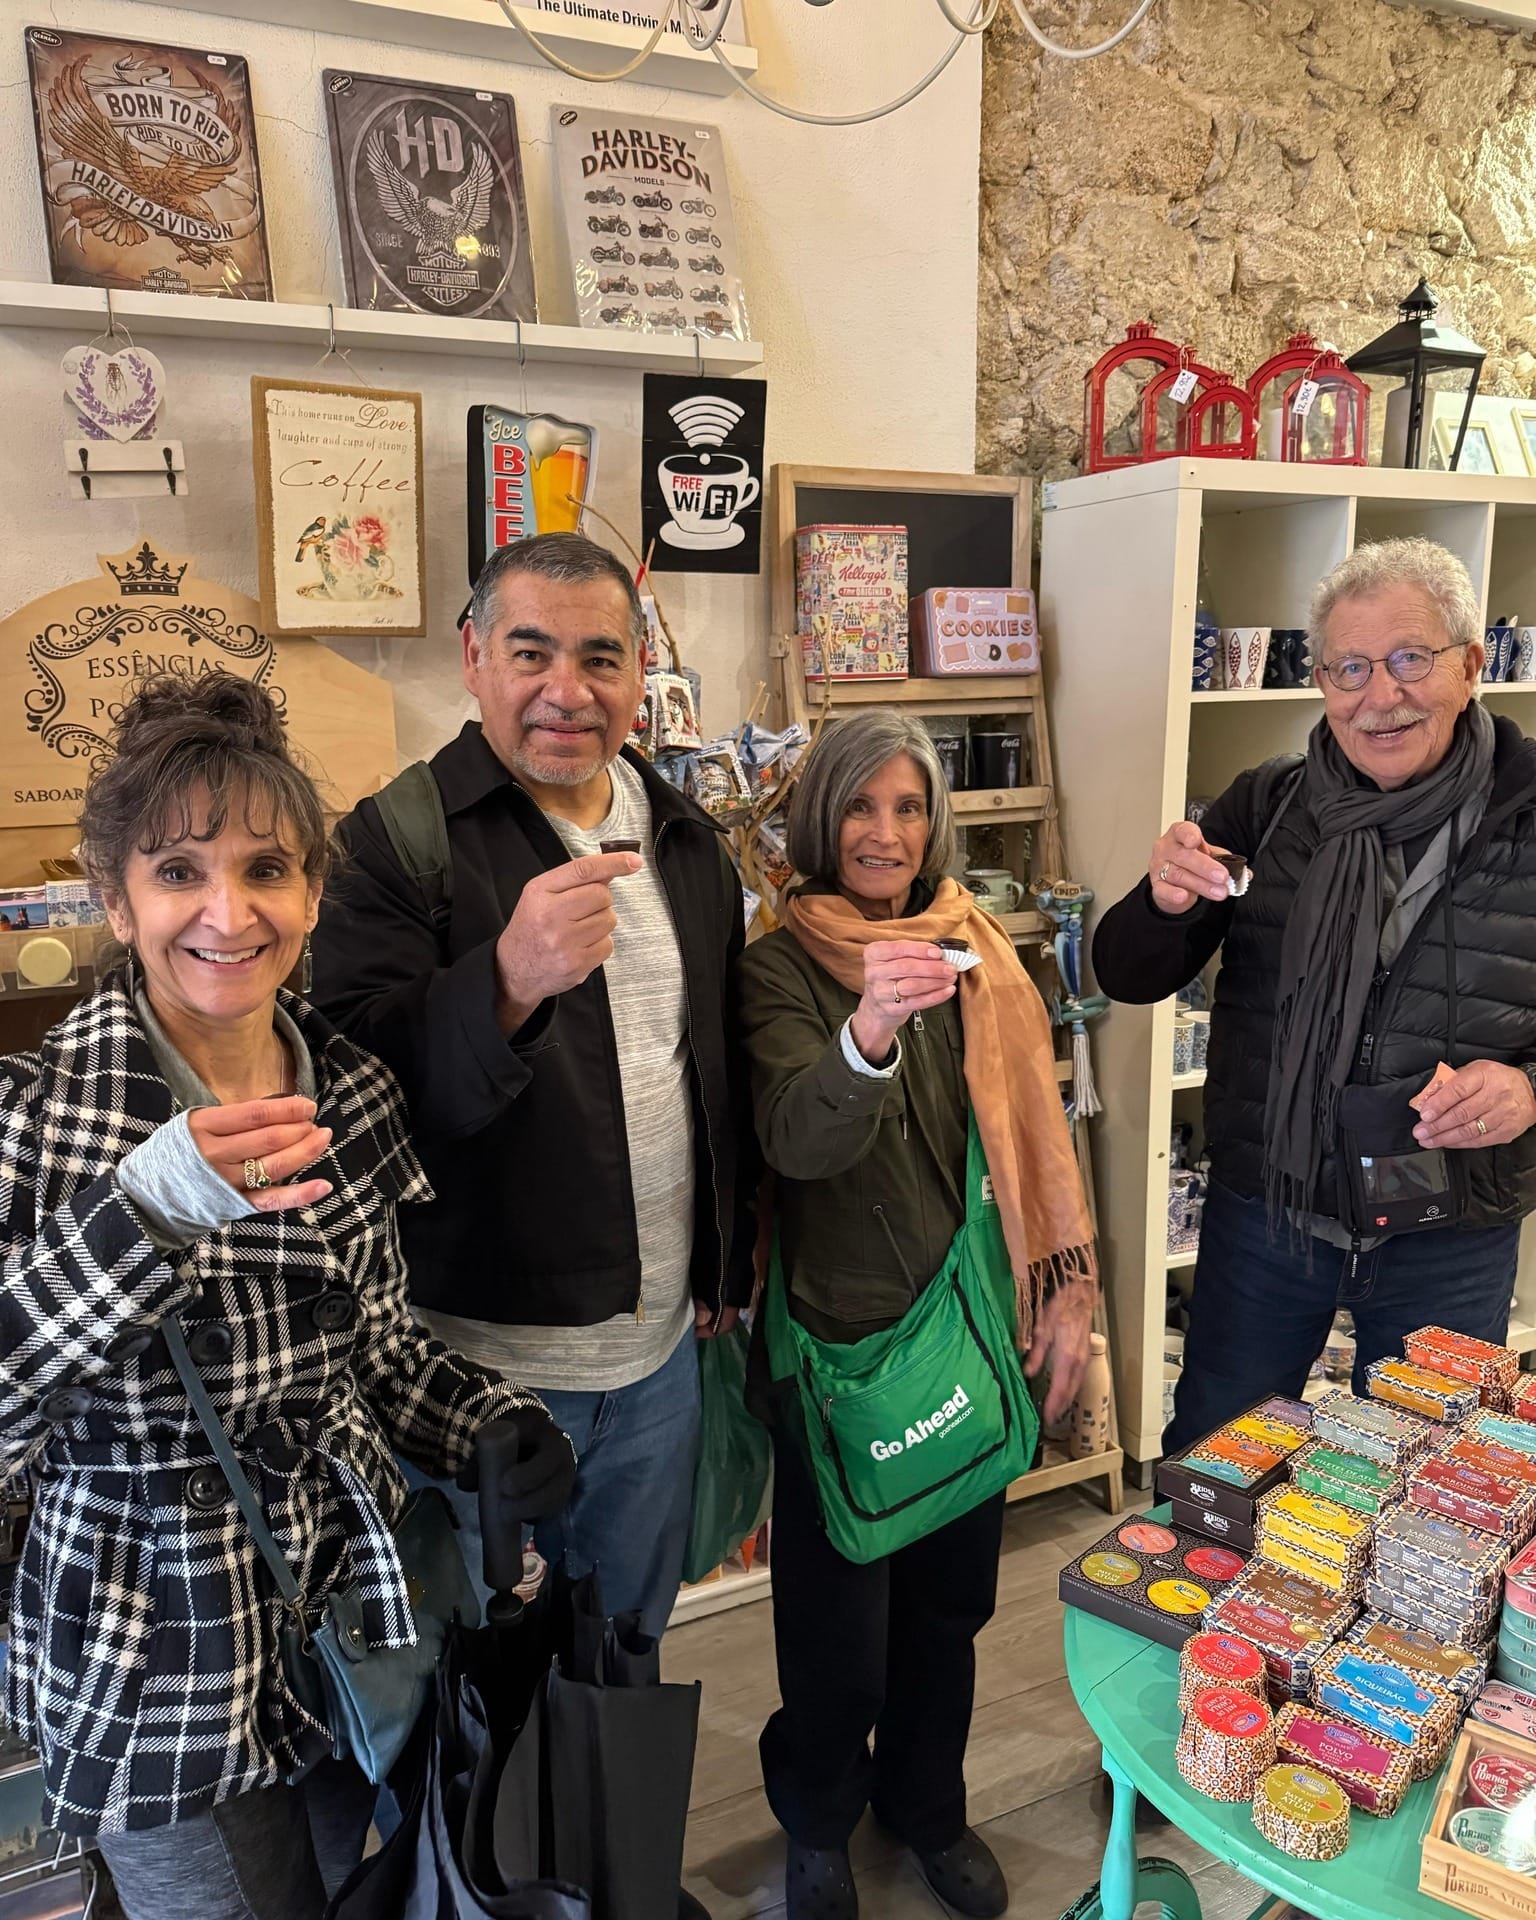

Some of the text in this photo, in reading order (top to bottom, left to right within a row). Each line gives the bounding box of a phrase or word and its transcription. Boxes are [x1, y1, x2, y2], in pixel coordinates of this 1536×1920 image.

[564, 1, 620, 22] Ultimate
[622, 10, 667, 33] Drivin
[104, 92, 230, 148] BORN TO RIDE
[137, 126, 221, 162] RIDE TO LIVE
[392, 107, 465, 179] H-D
[591, 128, 697, 161] HARLEY-
[581, 149, 714, 194] DAVIDSON
[633, 175, 665, 187] MODELS
[71, 161, 234, 240] HARLEY-DAVIDSON
[410, 269, 477, 287] HARLEY-DAVIDSON
[270, 398, 297, 417] This
[298, 407, 322, 420] home
[322, 413, 343, 422] runs
[344, 414, 355, 423] on
[278, 429, 408, 455] laughter and cups of strong
[488, 418, 522, 441] Ice
[279, 458, 411, 503] Coffee
[672, 475, 704, 491] FREE
[492, 442, 526, 548] BEE
[838, 562, 887, 585] Kellogg's
[940, 618, 1034, 637] COOKIES
[90, 698, 125, 723] PO
[14, 789, 86, 803] SABOAR
[870, 1384, 970, 1461] Go Ahead
[938, 1405, 975, 1439] goahead.com
[1440, 1475, 1493, 1498] SARDINHAS
[1408, 1528, 1461, 1554] SARDINHAS
[1265, 1585, 1315, 1610] SARDINHAS
[1222, 1608, 1301, 1649] FILETES DE CAVALA
[1383, 1641, 1440, 1669] SARDINHAS
[1319, 1742, 1353, 1760] POLVO
[1281, 1795, 1312, 1814] ATUM
[1444, 1862, 1489, 1896] PORTHOS
